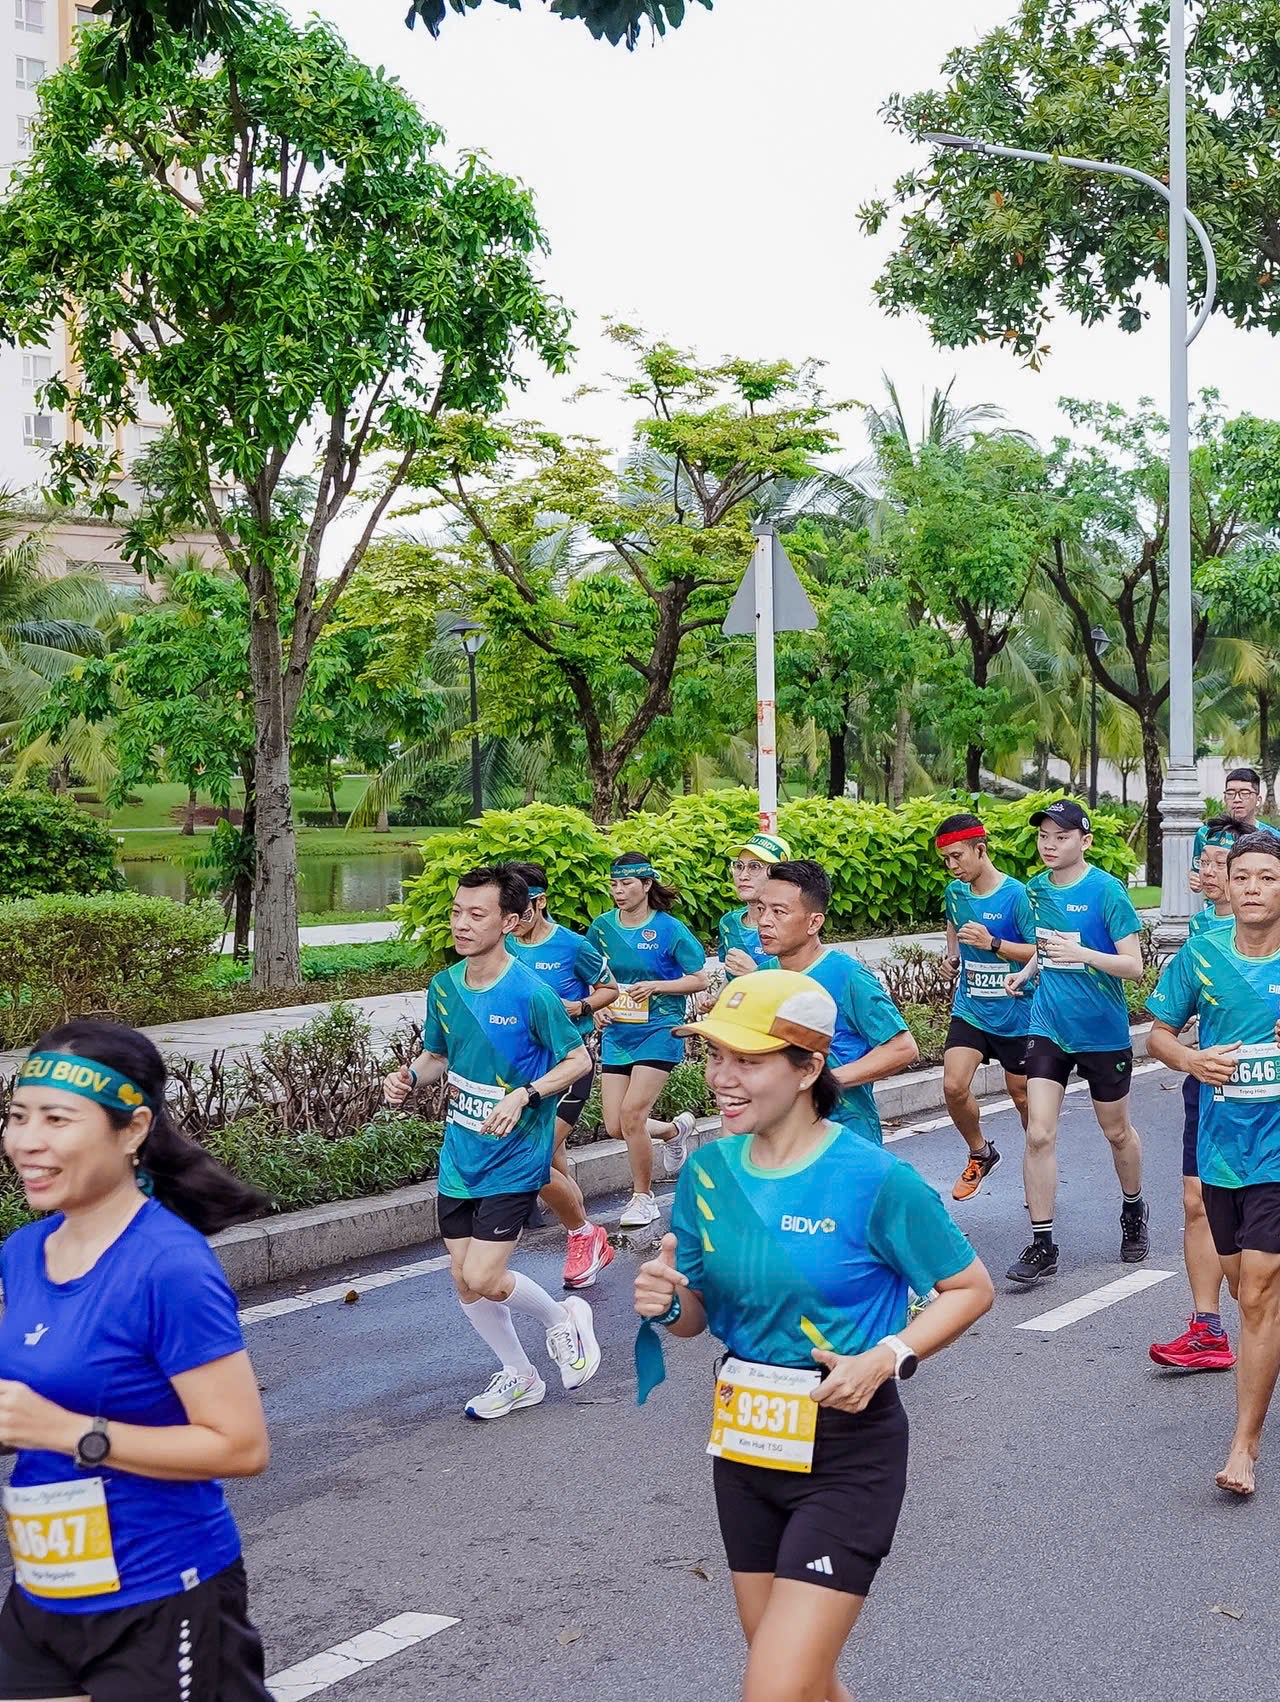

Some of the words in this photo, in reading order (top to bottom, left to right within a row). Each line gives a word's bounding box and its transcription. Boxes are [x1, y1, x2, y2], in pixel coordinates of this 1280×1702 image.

[974, 973, 1004, 987] 8244
[489, 1014, 509, 1026] BIDV
[52, 1061, 112, 1093] BIDV
[458, 1092, 494, 1120] 8436
[781, 1214, 822, 1235] BIDV
[737, 1391, 800, 1435] 9331
